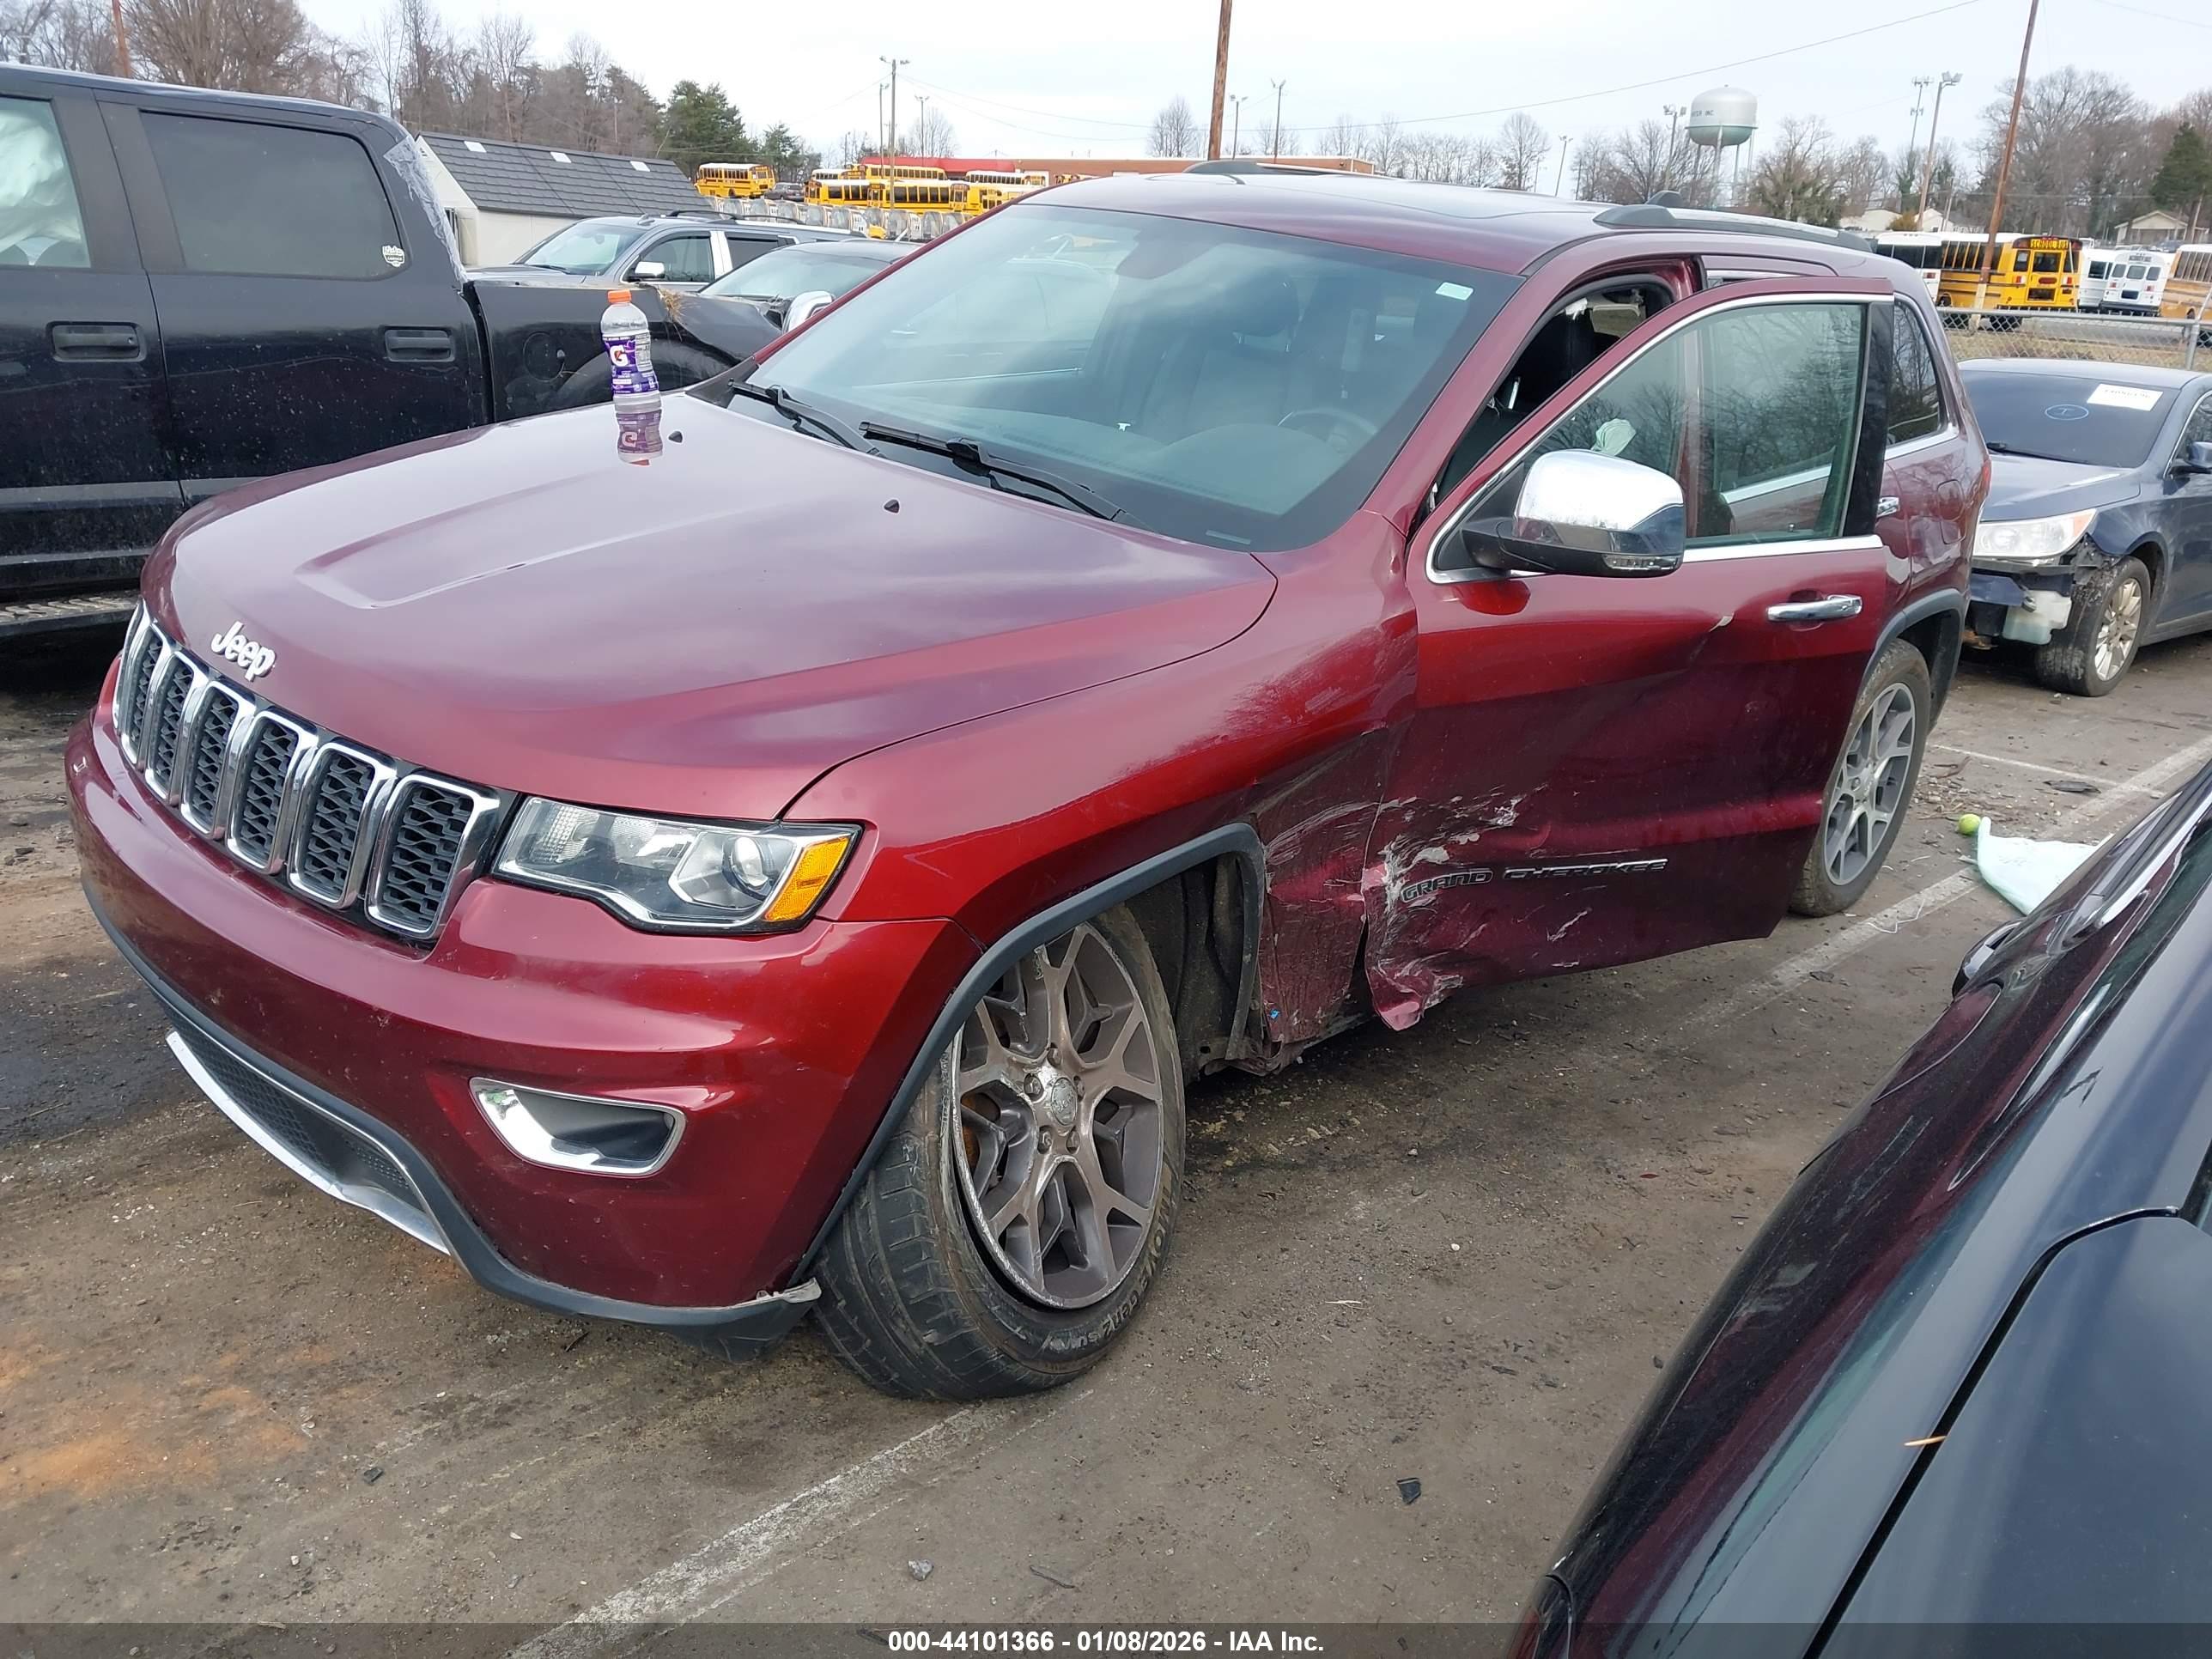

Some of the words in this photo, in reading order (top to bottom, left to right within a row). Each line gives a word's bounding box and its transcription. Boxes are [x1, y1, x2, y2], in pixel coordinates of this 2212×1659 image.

[610, 344, 629, 367] G
[210, 621, 276, 682] Jeep
[1401, 868, 1494, 902] GRAND
[1503, 858, 1669, 880] CHEROKEE
